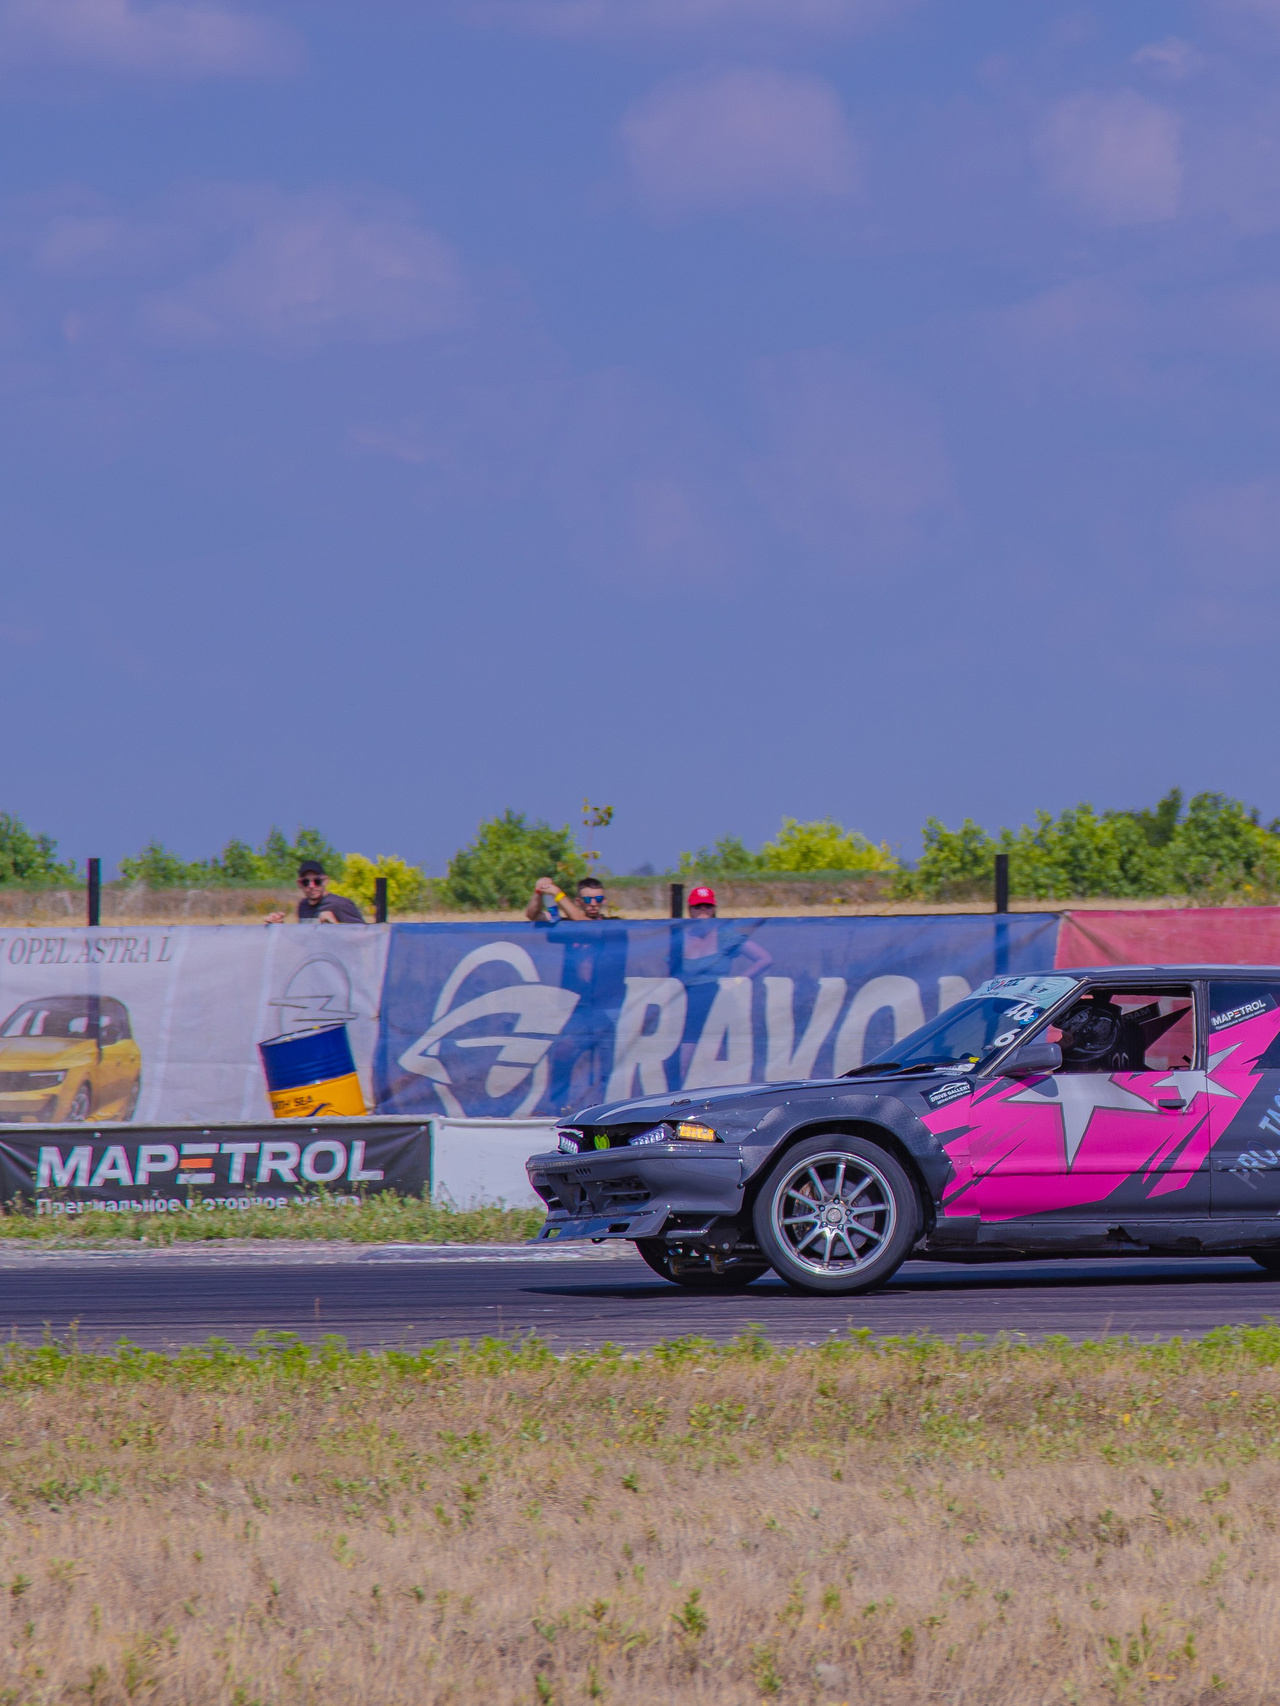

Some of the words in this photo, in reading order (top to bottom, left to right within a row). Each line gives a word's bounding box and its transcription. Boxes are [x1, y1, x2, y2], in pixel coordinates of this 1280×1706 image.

[8, 937, 69, 965] OPEL
[72, 936, 150, 964] ASTRA
[156, 936, 171, 963] L
[1211, 1000, 1267, 1026] MAPETROL
[35, 1139, 385, 1189] MAPETROL
